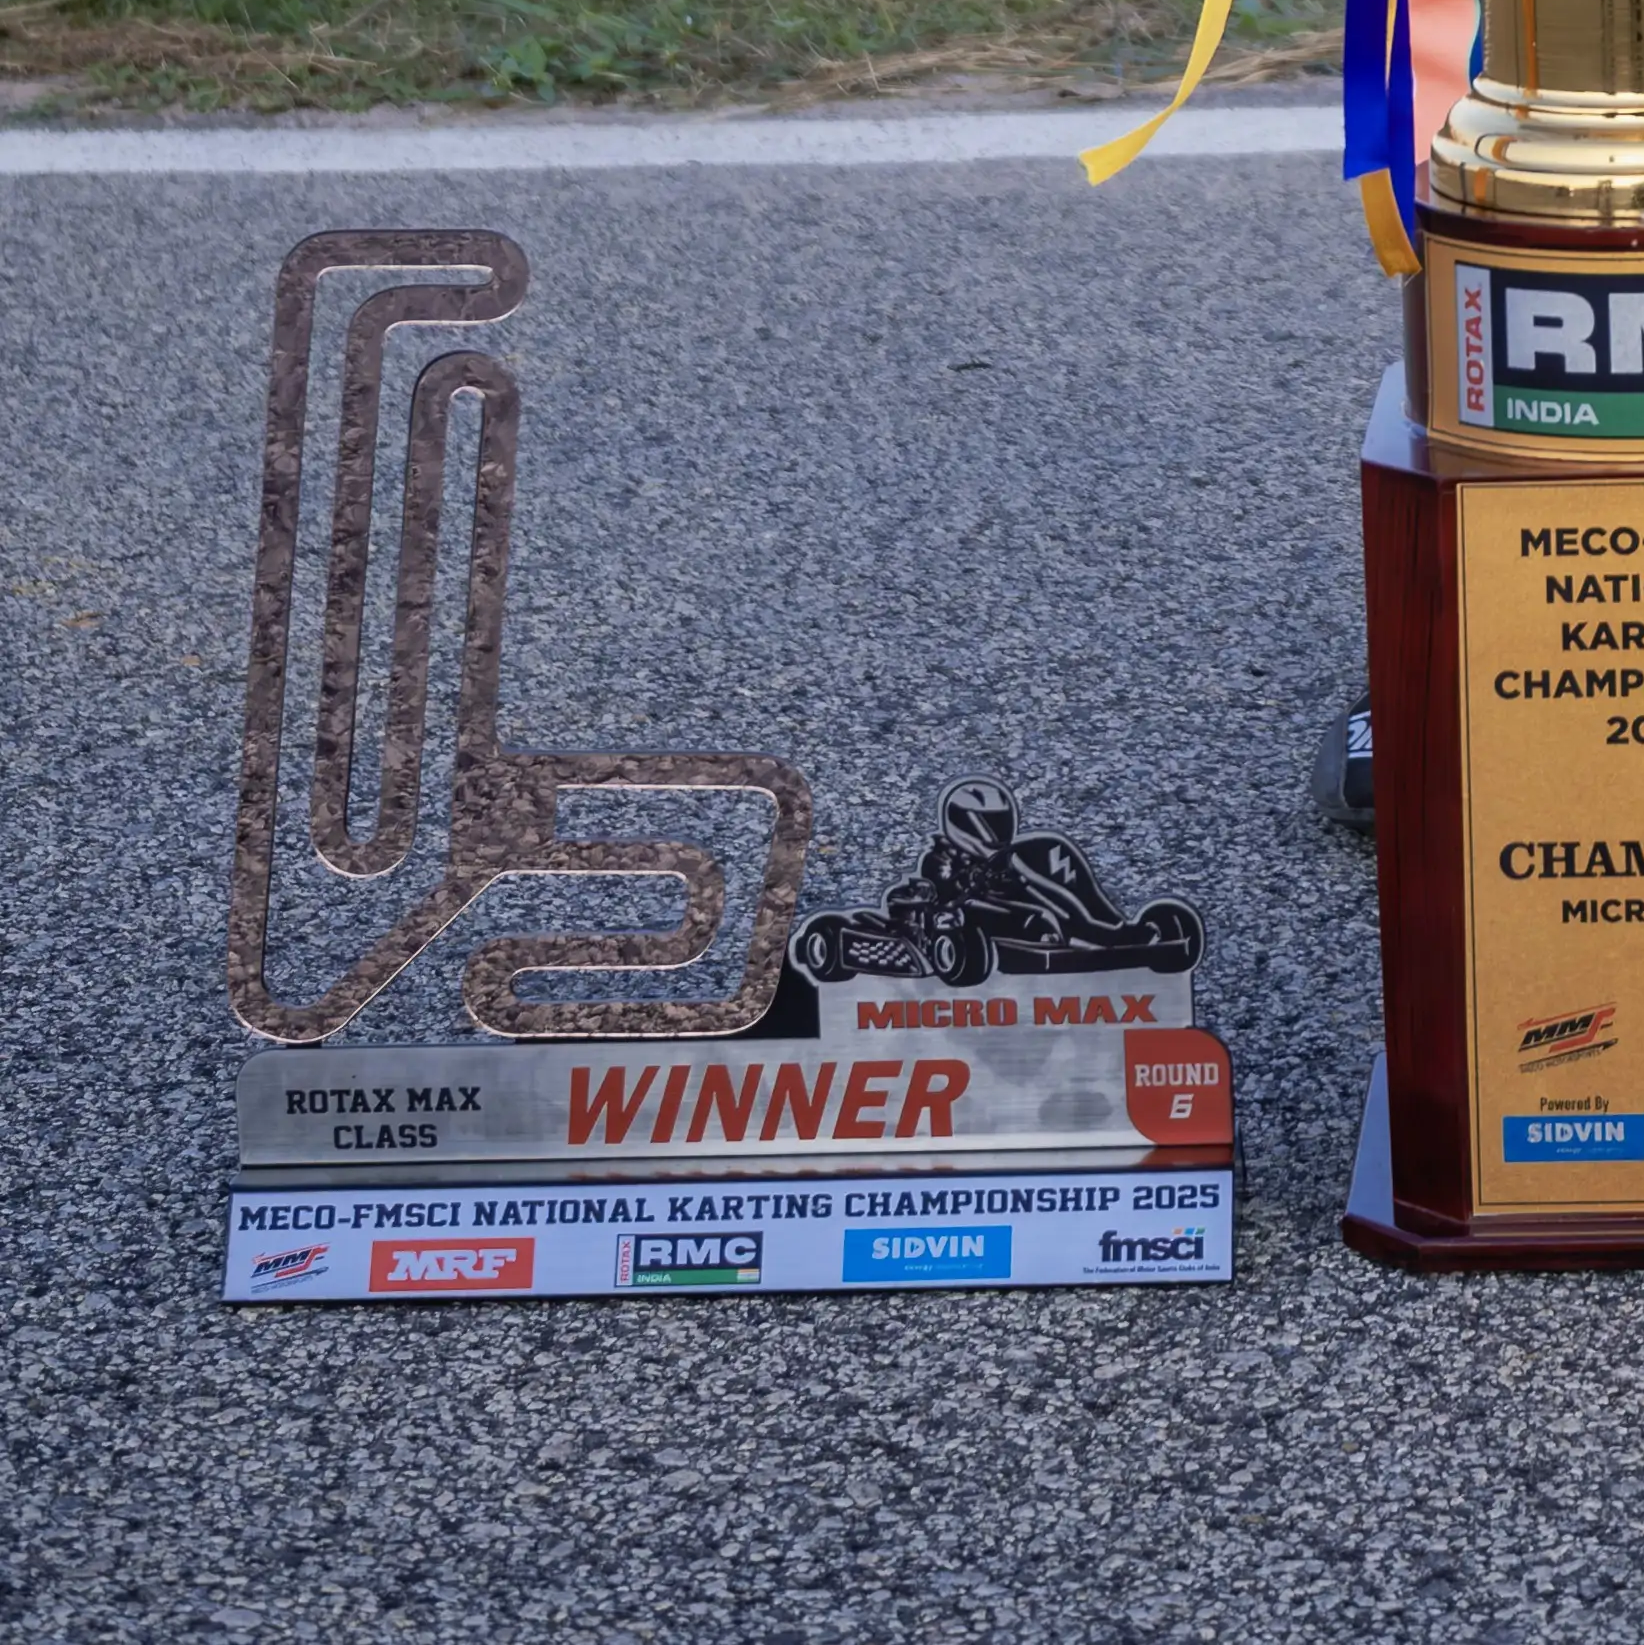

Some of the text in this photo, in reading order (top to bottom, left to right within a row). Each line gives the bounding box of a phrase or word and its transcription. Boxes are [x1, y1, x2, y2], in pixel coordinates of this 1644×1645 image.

[1464, 284, 1485, 412] ROTAX
[1506, 397, 1600, 426] INDIA
[857, 993, 1159, 1030] MICRO MAX
[1134, 1062, 1220, 1087] ROUND
[285, 1085, 482, 1116] ROTAX MAX
[567, 1058, 972, 1145] WINNER
[1168, 1093, 1195, 1119] 6
[1539, 1095, 1610, 1114] Powered By
[332, 1123, 439, 1150] CLASS
[1526, 1121, 1626, 1144] SIDVIN
[238, 1183, 1221, 1232] MECO-FMSCI NATIONAL KARTING CHAMPIONSHIP 2025
[638, 1236, 758, 1267] RMC
[870, 1234, 985, 1260] SIDVIN
[1098, 1226, 1206, 1263] fmsci
[387, 1248, 517, 1282] MRF
[619, 1239, 632, 1282] ROTAX
